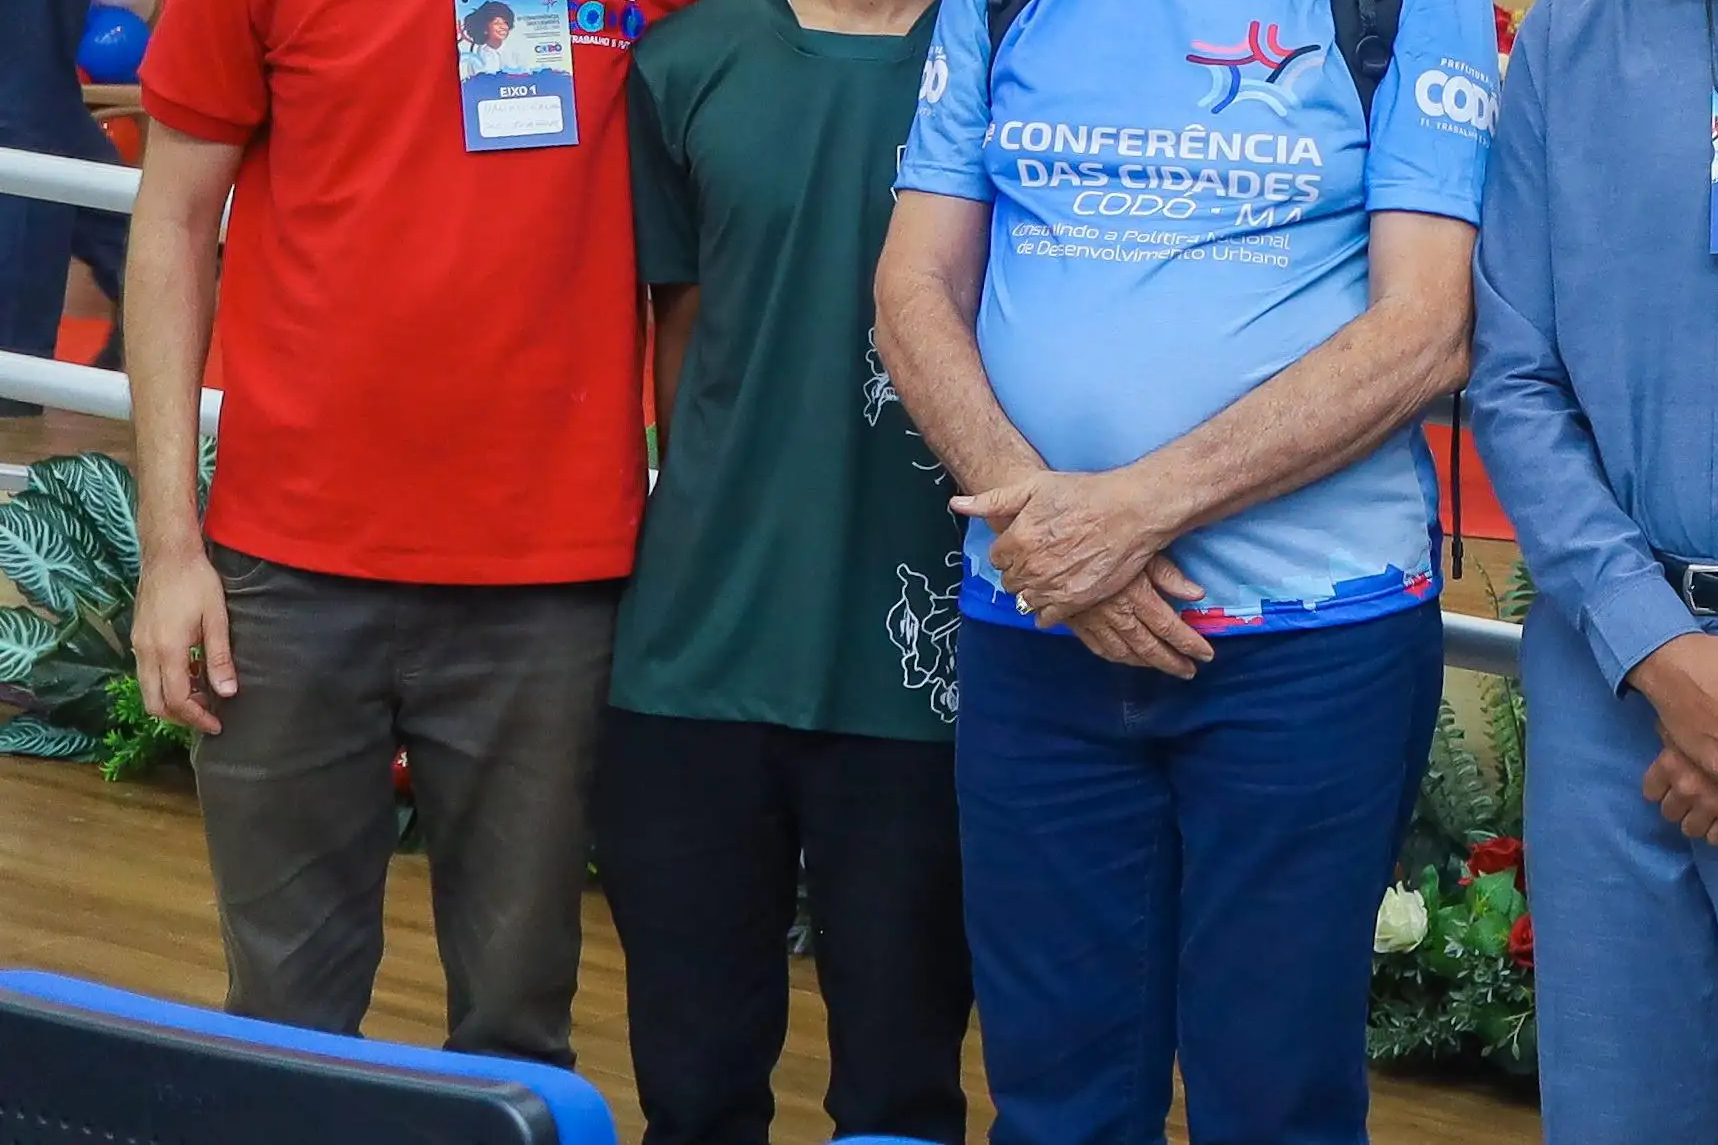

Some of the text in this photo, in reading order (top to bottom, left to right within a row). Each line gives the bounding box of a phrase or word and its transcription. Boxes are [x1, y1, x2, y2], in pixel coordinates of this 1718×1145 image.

[500, 85, 537, 97] EIXO 1
[1000, 121, 1323, 166] CONFERÊNCIA
[1016, 158, 1322, 202] DAS CIDADES
[1072, 191, 1198, 219] CODÓ
[1016, 239, 1034, 255] de
[1212, 246, 1289, 268] Urbano
